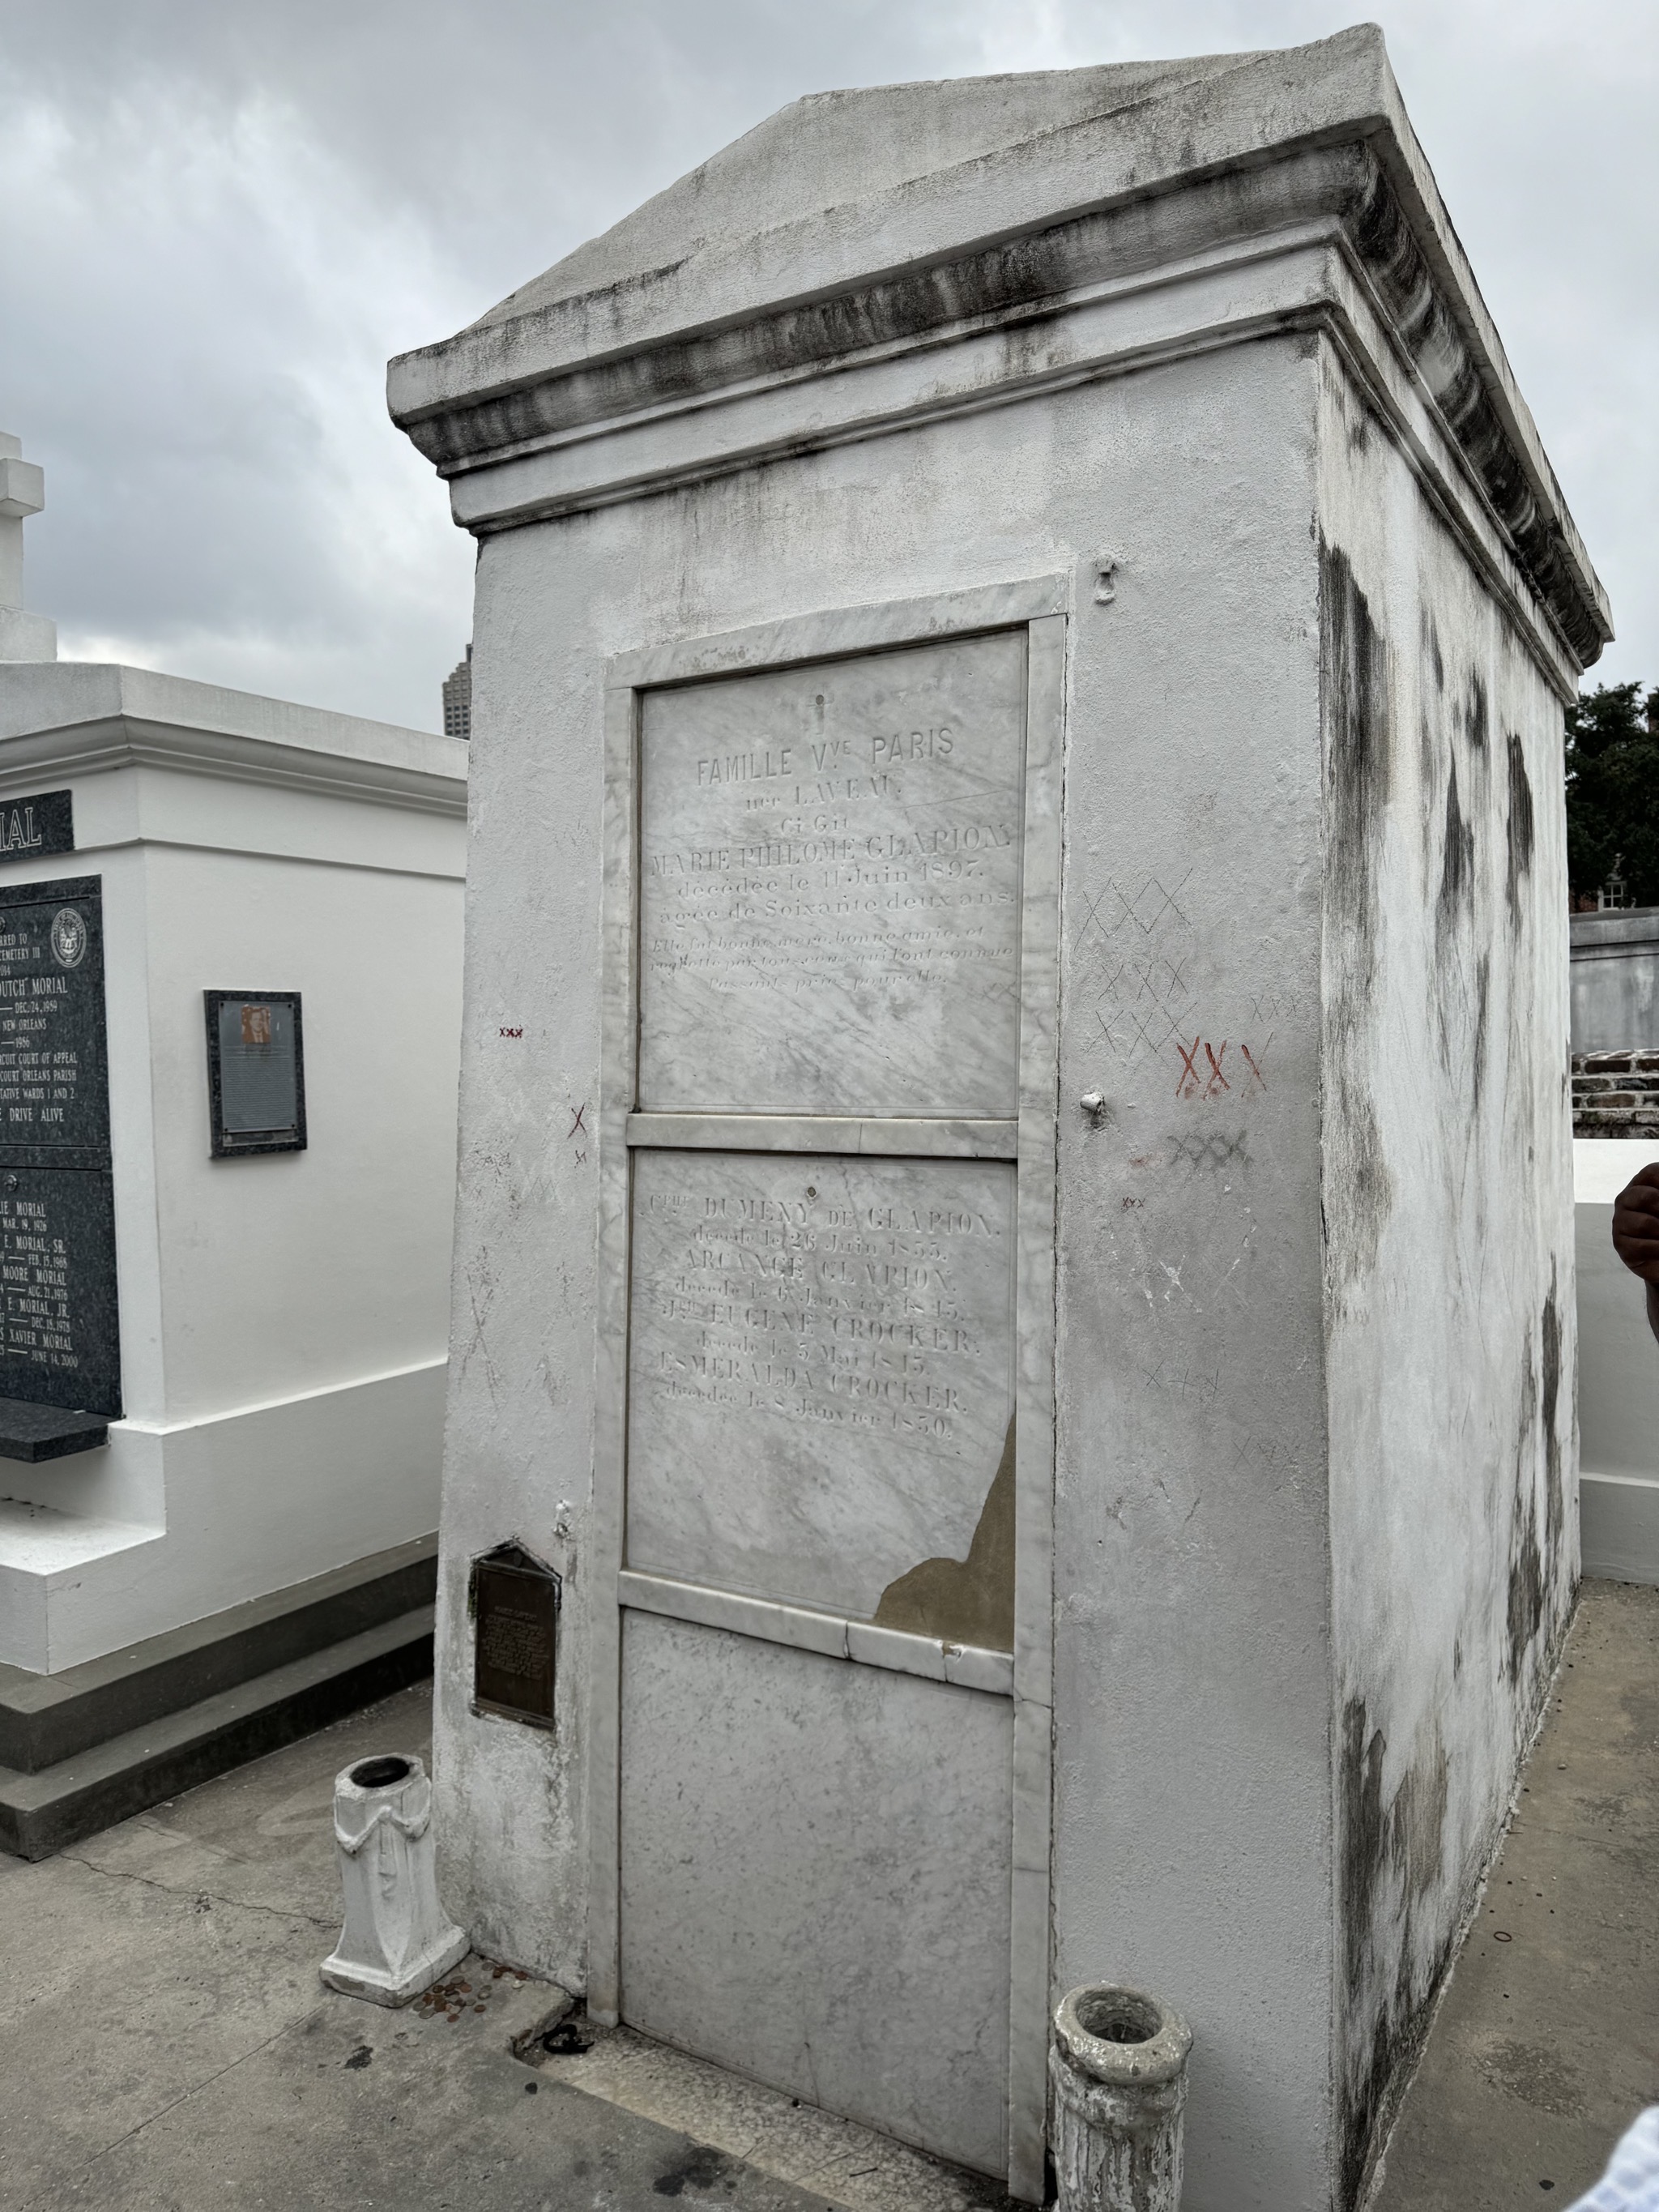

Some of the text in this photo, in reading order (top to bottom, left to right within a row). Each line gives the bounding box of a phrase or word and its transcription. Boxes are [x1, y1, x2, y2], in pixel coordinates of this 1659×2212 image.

[697, 748, 792, 786] FAMILLE
[872, 727, 954, 765] PARIS
[781, 817, 801, 834] Ci
[650, 849, 731, 877] MARIE
[740, 839, 856, 869] PHILOME
[788, 873, 810, 891] le
[847, 866, 909, 886] Juin
[728, 902, 756, 920] de
[765, 898, 877, 918] Soixante
[886, 892, 951, 911] deux
[959, 890, 1016, 907] ans.
[19, 933, 28, 945] TO
[652, 938, 689, 953] Elle
[690, 937, 716, 951] fut
[719, 936, 772, 950] bonne
[835, 931, 897, 945] bonne
[966, 926, 984, 938] et
[856, 949, 886, 967] qui
[0, 976, 68, 997] UTCH" MORIAL
[853, 976, 902, 992] pour
[2, 1018, 47, 1031] NEW ORLEANS
[19, 1053, 39, 1065] COURT
[42, 1052, 51, 1064] OF
[53, 1052, 78, 1064] APPEAL
[0, 1070, 77, 1082] COURT ORLEANS PARISH
[23, 1087, 45, 1099] WARDS
[53, 1087, 67, 1099] AND
[70, 1087, 75, 1099] 2
[10, 1108, 33, 1121] DRIVE
[41, 1108, 64, 1122] ALIVE
[16, 1202, 46, 1217] MORIAL
[2, 1217, 19, 1229] MAR.
[33, 1219, 47, 1232] 1926
[4, 1234, 11, 1249] E.
[53, 1239, 66, 1253] SR.
[765, 1229, 780, 1246] le
[790, 1230, 817, 1251] 26
[825, 1233, 878, 1256] Juin
[3, 1265, 66, 1286] MOORE MORIAL
[28, 1285, 43, 1297] AUG.
[53, 1288, 68, 1301] 1976
[750, 1282, 767, 1300] le
[7, 1296, 15, 1311] E.
[58, 1303, 70, 1318] JR.
[32, 1316, 45, 1329] DEC.
[711, 1304, 815, 1335] EUGENE
[9, 1328, 36, 1346] XAVIER
[43, 1333, 73, 1352] MORIAL
[771, 1339, 788, 1357] le
[31, 1350, 47, 1363] JUNE
[61, 1354, 79, 1369] 2000
[660, 1350, 815, 1391] ESMERALDA
[748, 1390, 766, 1409] le
